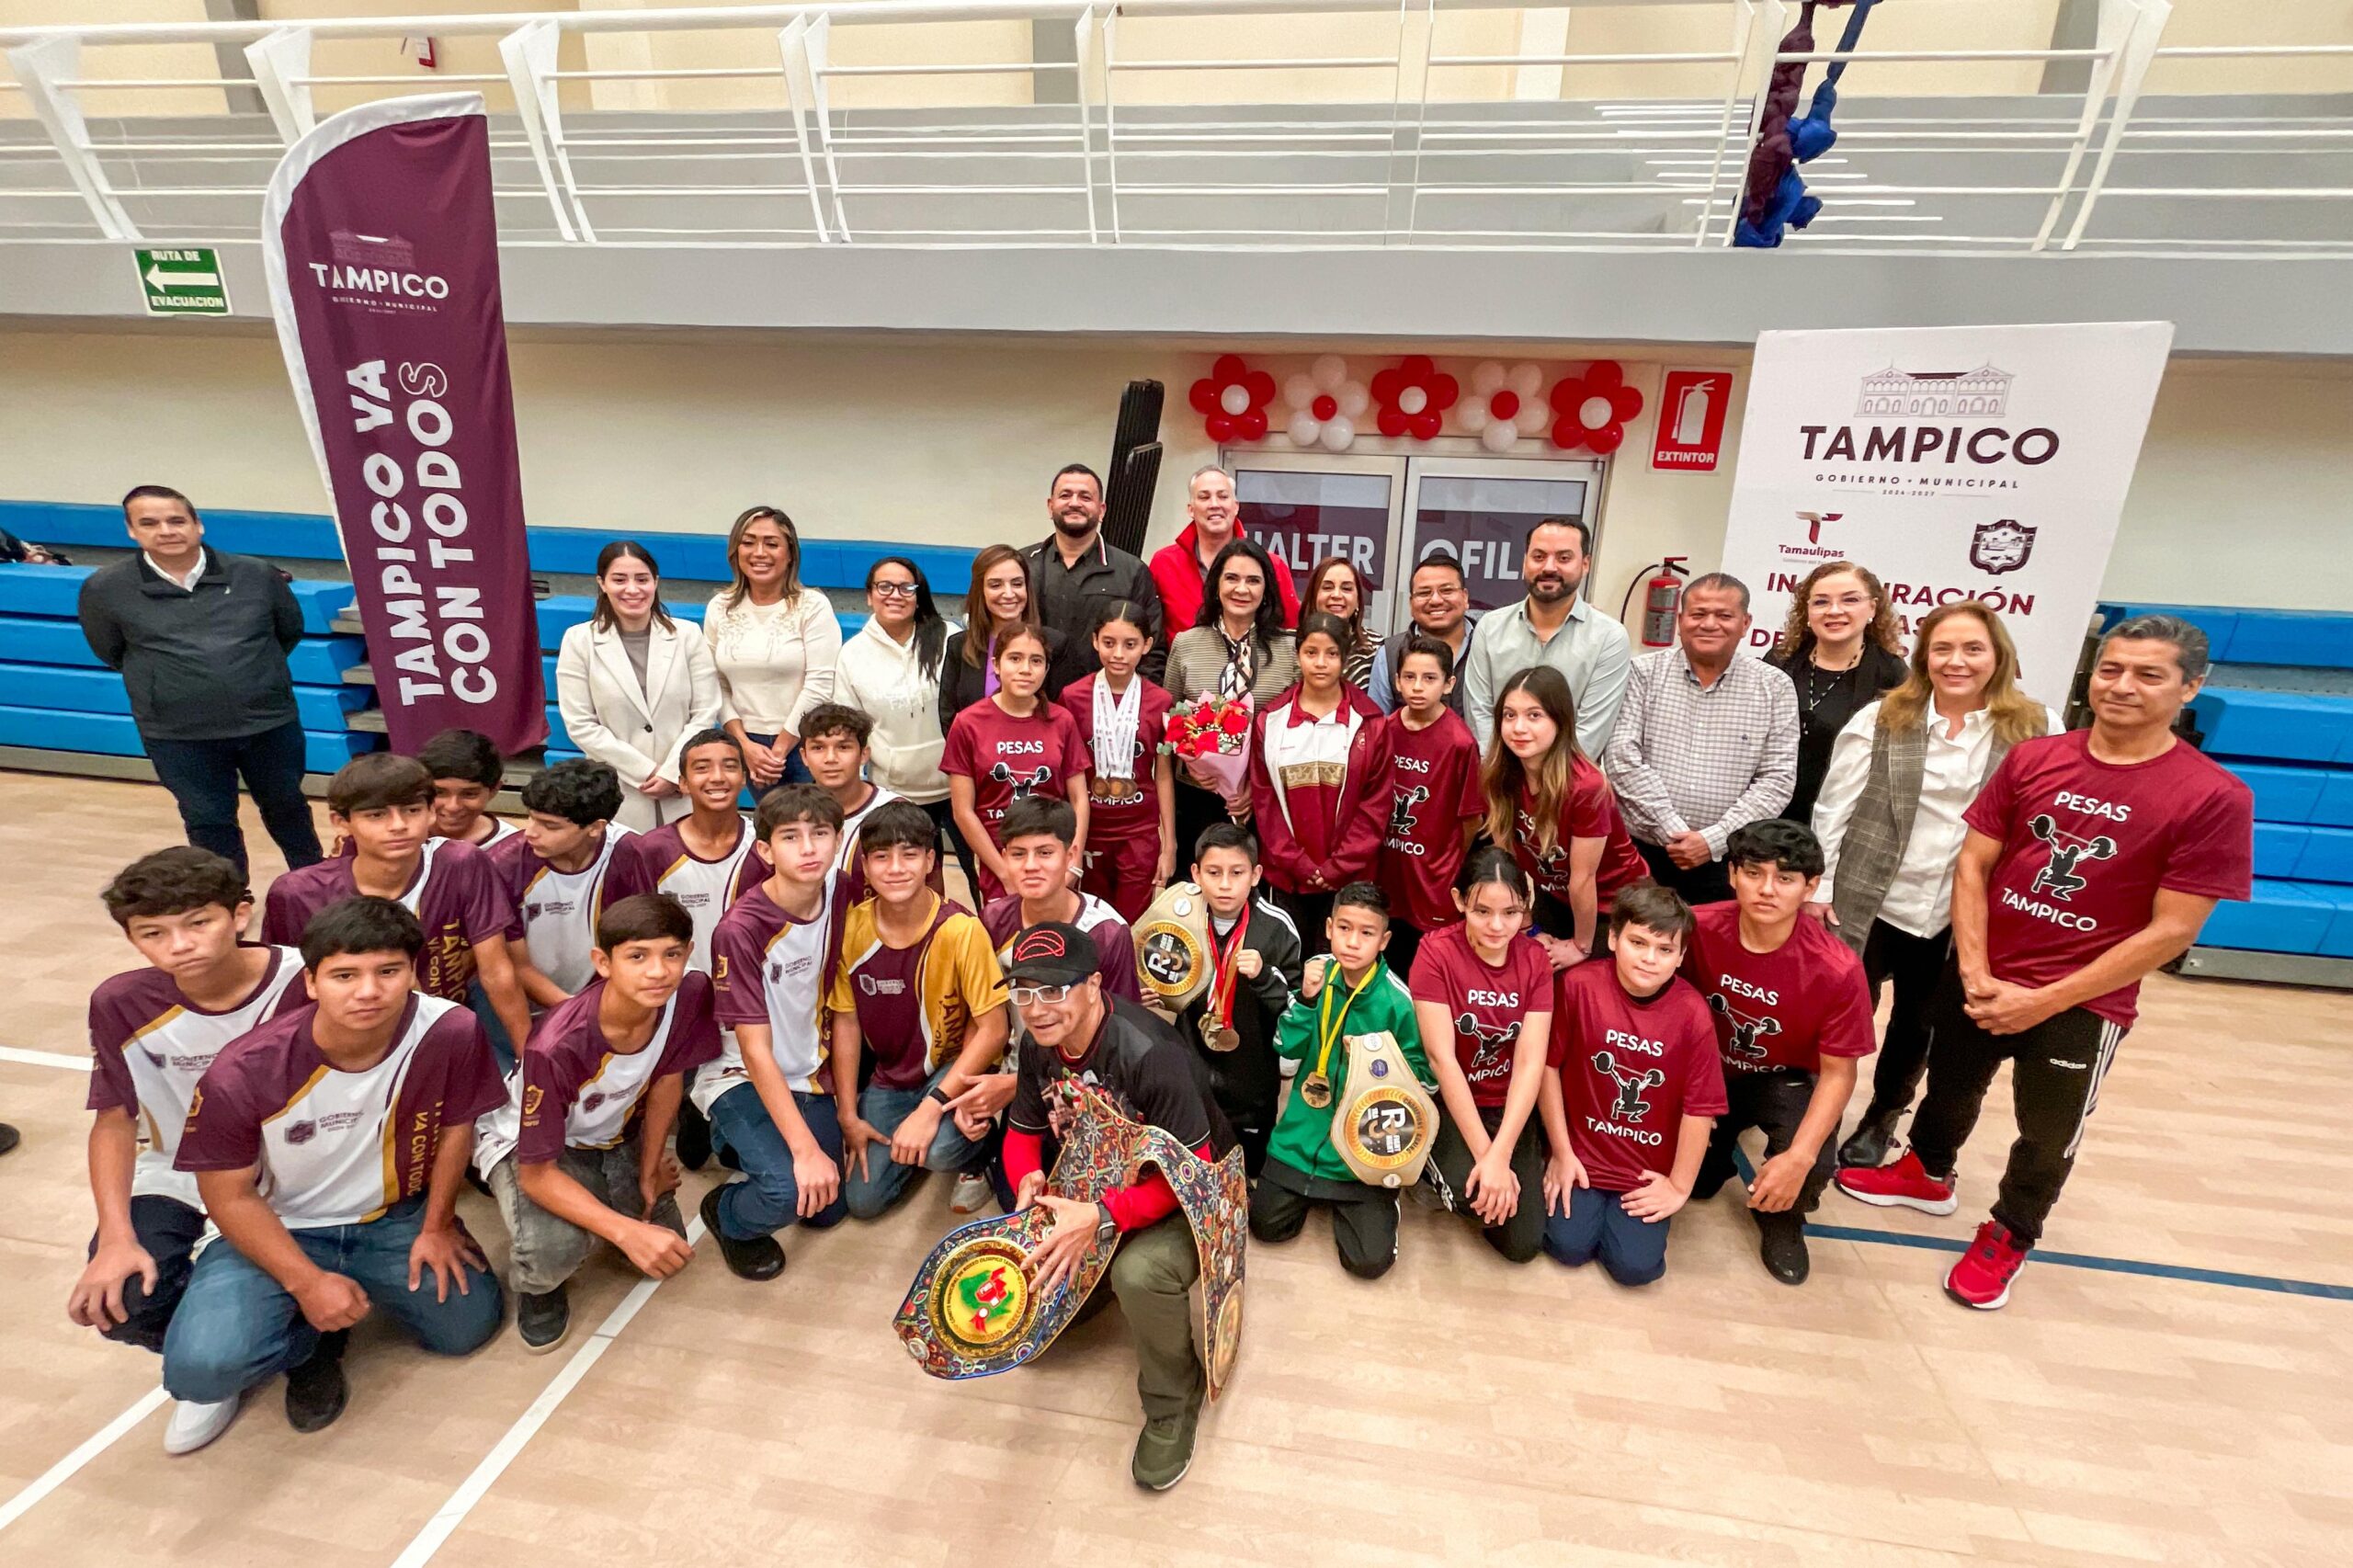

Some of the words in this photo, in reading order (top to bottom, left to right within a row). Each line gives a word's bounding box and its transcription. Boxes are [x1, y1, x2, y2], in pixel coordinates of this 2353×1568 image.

[151, 250, 183, 261] RUTA
[183, 250, 201, 261] DE
[309, 262, 449, 300] TAMPICO
[151, 296, 224, 308] EVACUACION
[346, 359, 394, 434] VA
[1656, 450, 1715, 463] EXTINTOR
[1800, 426, 2060, 466] TAMPICO
[397, 361, 475, 569] TODOS
[1815, 473, 1900, 485] GOBIERNO
[1919, 477, 2020, 489] MUNICIPAL
[1779, 544, 1846, 559] Tamaulipas
[363, 452, 446, 707] TAMPICO
[435, 585, 498, 704] CON
[996, 740, 1044, 755] PESAS
[2053, 790, 2132, 823] PESAS
[1383, 836, 1426, 857] MPICO
[2001, 887, 2097, 932] TAMPICO
[429, 955, 442, 988] CON
[1468, 989, 1519, 1007] PESAS
[1720, 974, 1779, 1006] PESAS
[1605, 1028, 1665, 1057] PESAS
[1468, 1058, 1511, 1083] MPICO
[2050, 1058, 2087, 1070] adidas
[414, 1110, 428, 1132] VA
[1586, 1115, 1663, 1146] TAMPICO
[411, 1135, 427, 1165] CON
